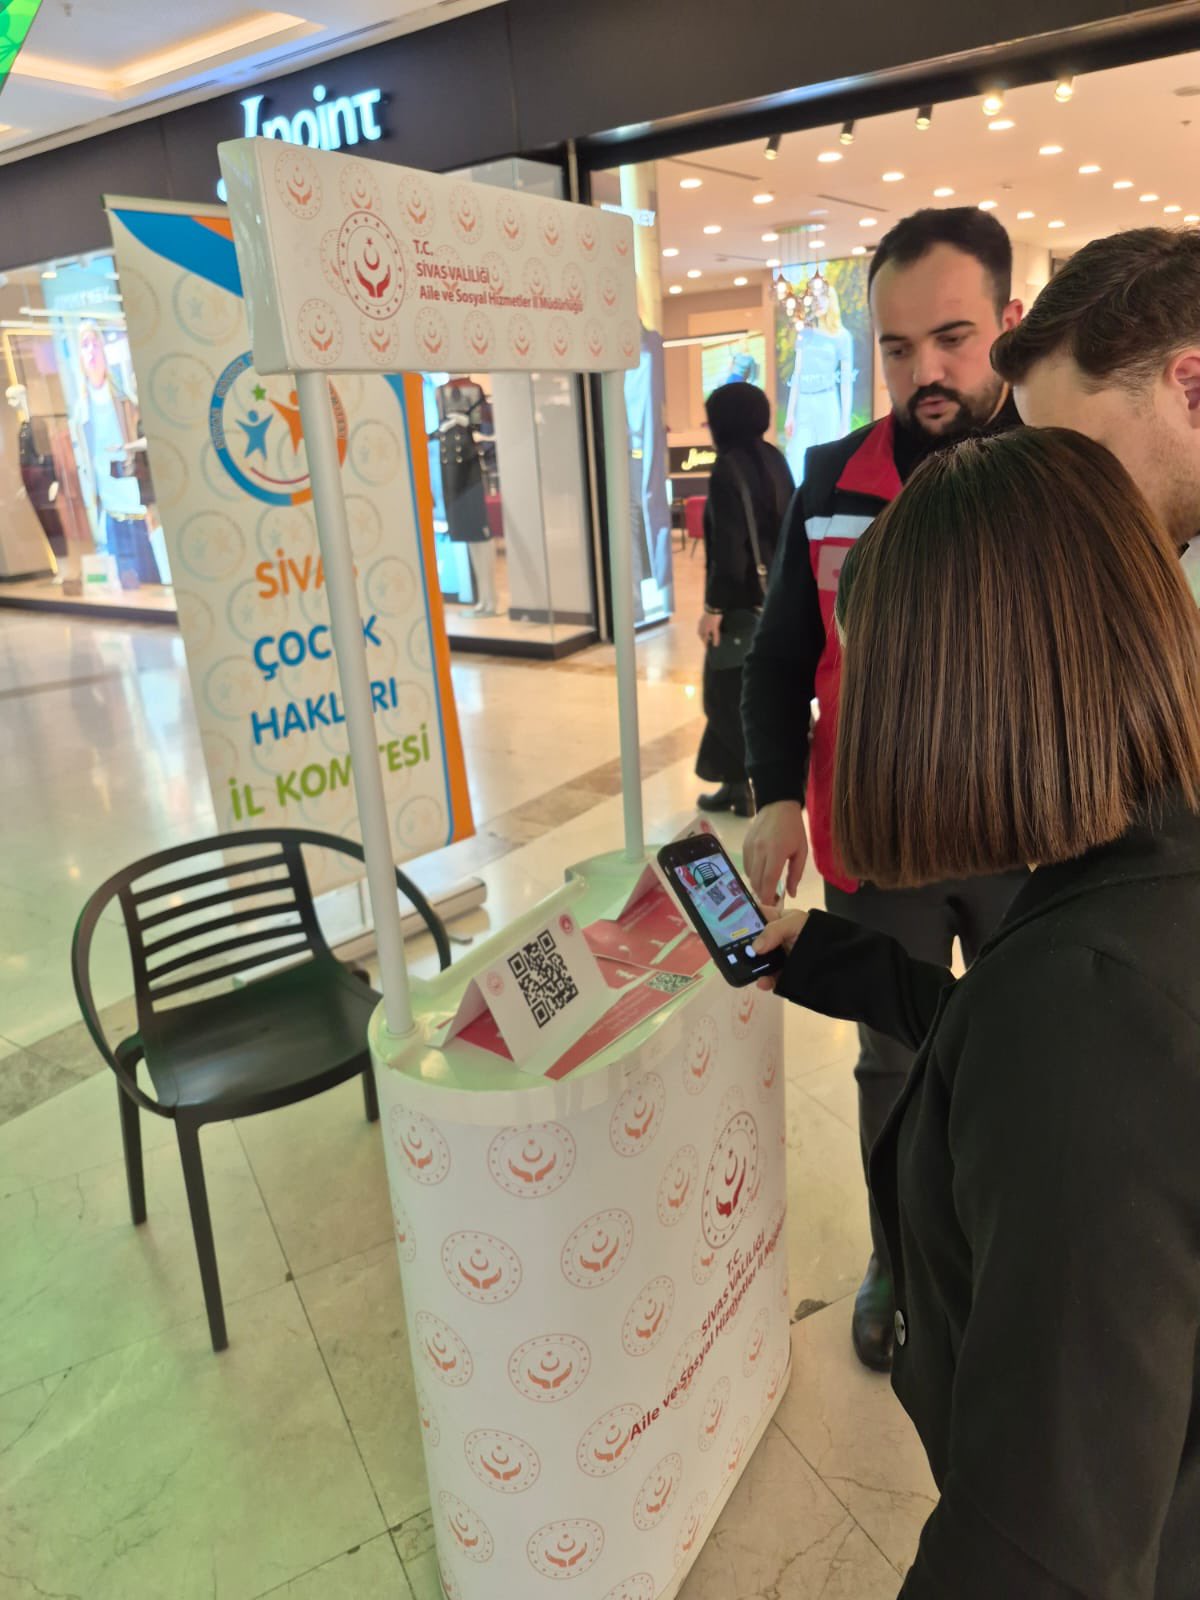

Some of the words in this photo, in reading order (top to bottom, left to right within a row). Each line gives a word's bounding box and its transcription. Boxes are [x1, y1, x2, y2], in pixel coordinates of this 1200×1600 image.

[413, 240, 434, 256] T.C.
[416, 260, 447, 280] SİVAS
[419, 286, 440, 301] Aile
[443, 291, 454, 302] ve
[456, 289, 487, 307] Sosyal
[255, 548, 358, 600] SİV
[254, 614, 382, 681] ÇOCK
[251, 677, 399, 745] HAKLRI
[228, 777, 265, 821] İL
[276, 722, 430, 808] KOMESİ
[727, 1247, 742, 1275] T.C.
[702, 1288, 729, 1336] SİVAS
[631, 1407, 660, 1440] Aile
[663, 1387, 678, 1408] ve
[680, 1332, 714, 1390] Sosyal
